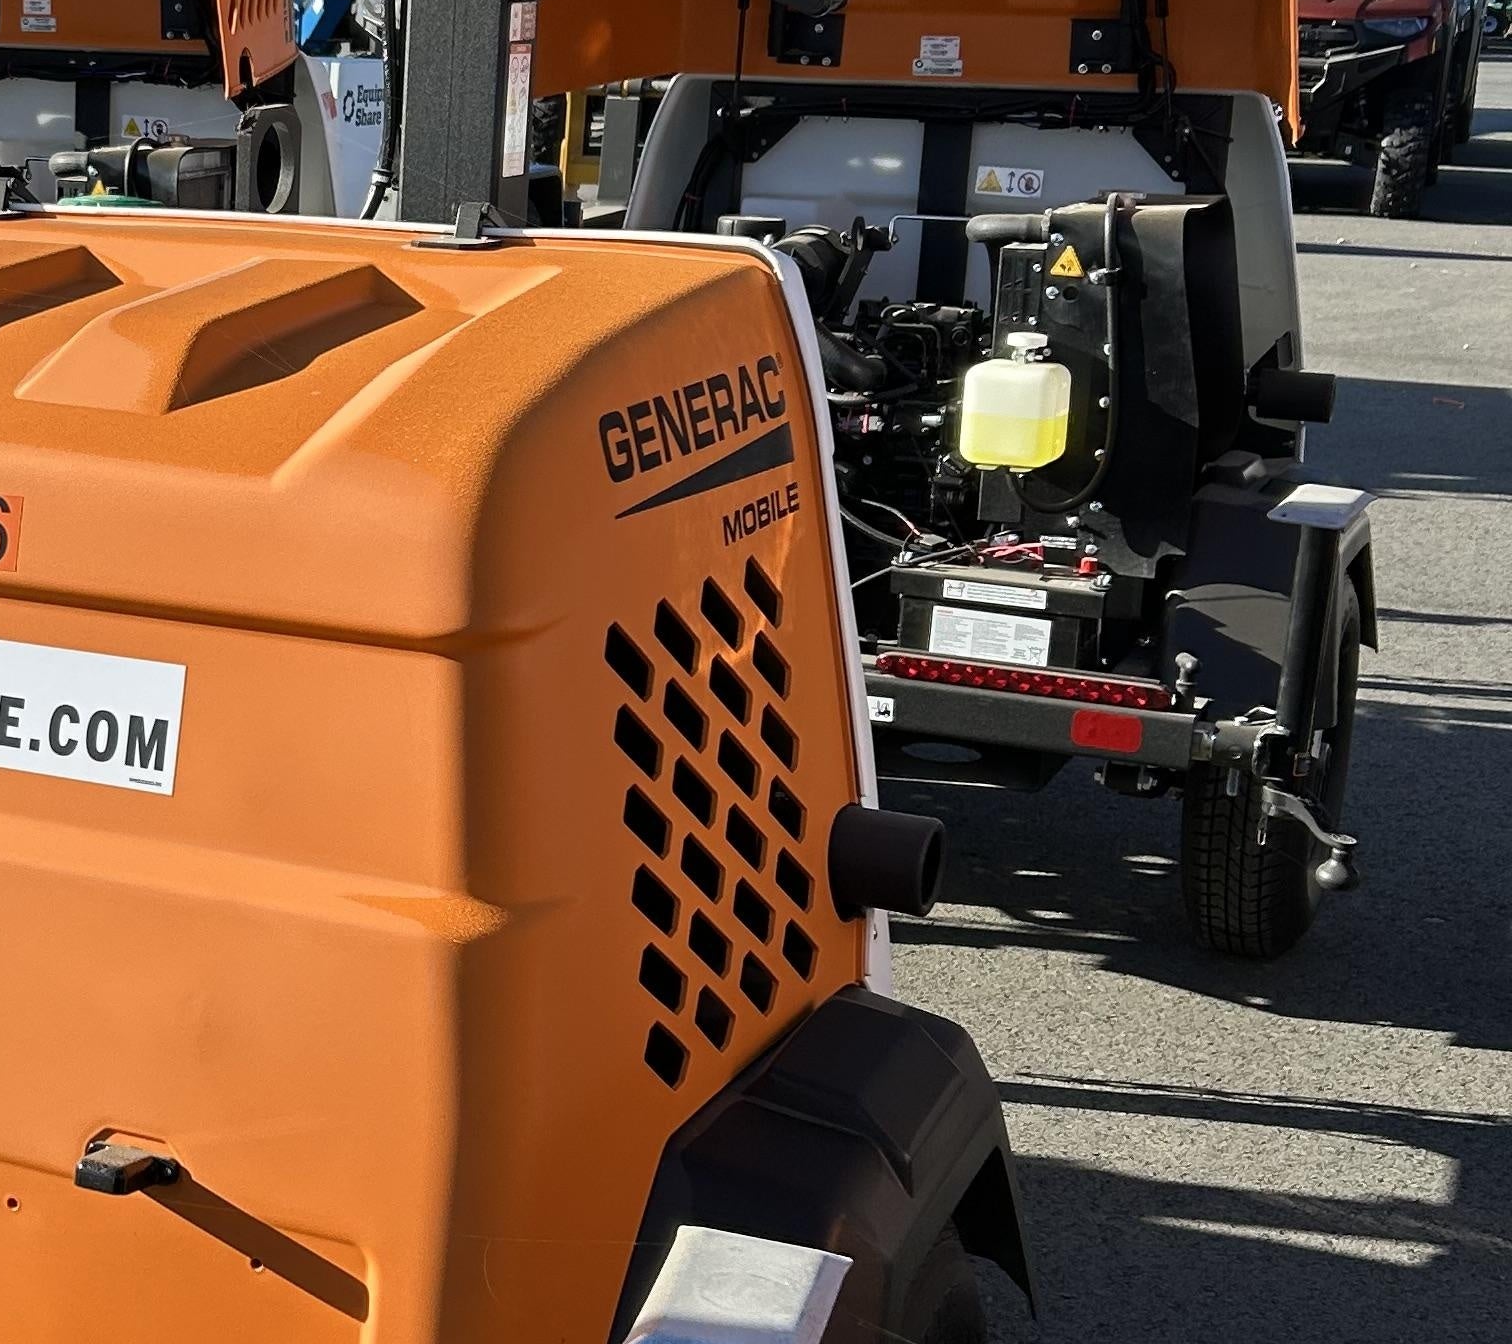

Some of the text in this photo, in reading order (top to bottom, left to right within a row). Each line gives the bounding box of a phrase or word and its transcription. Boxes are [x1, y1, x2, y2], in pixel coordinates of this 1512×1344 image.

[355, 107, 382, 127] Share
[598, 355, 786, 483] GENERAC
[722, 481, 800, 547] MOBILE
